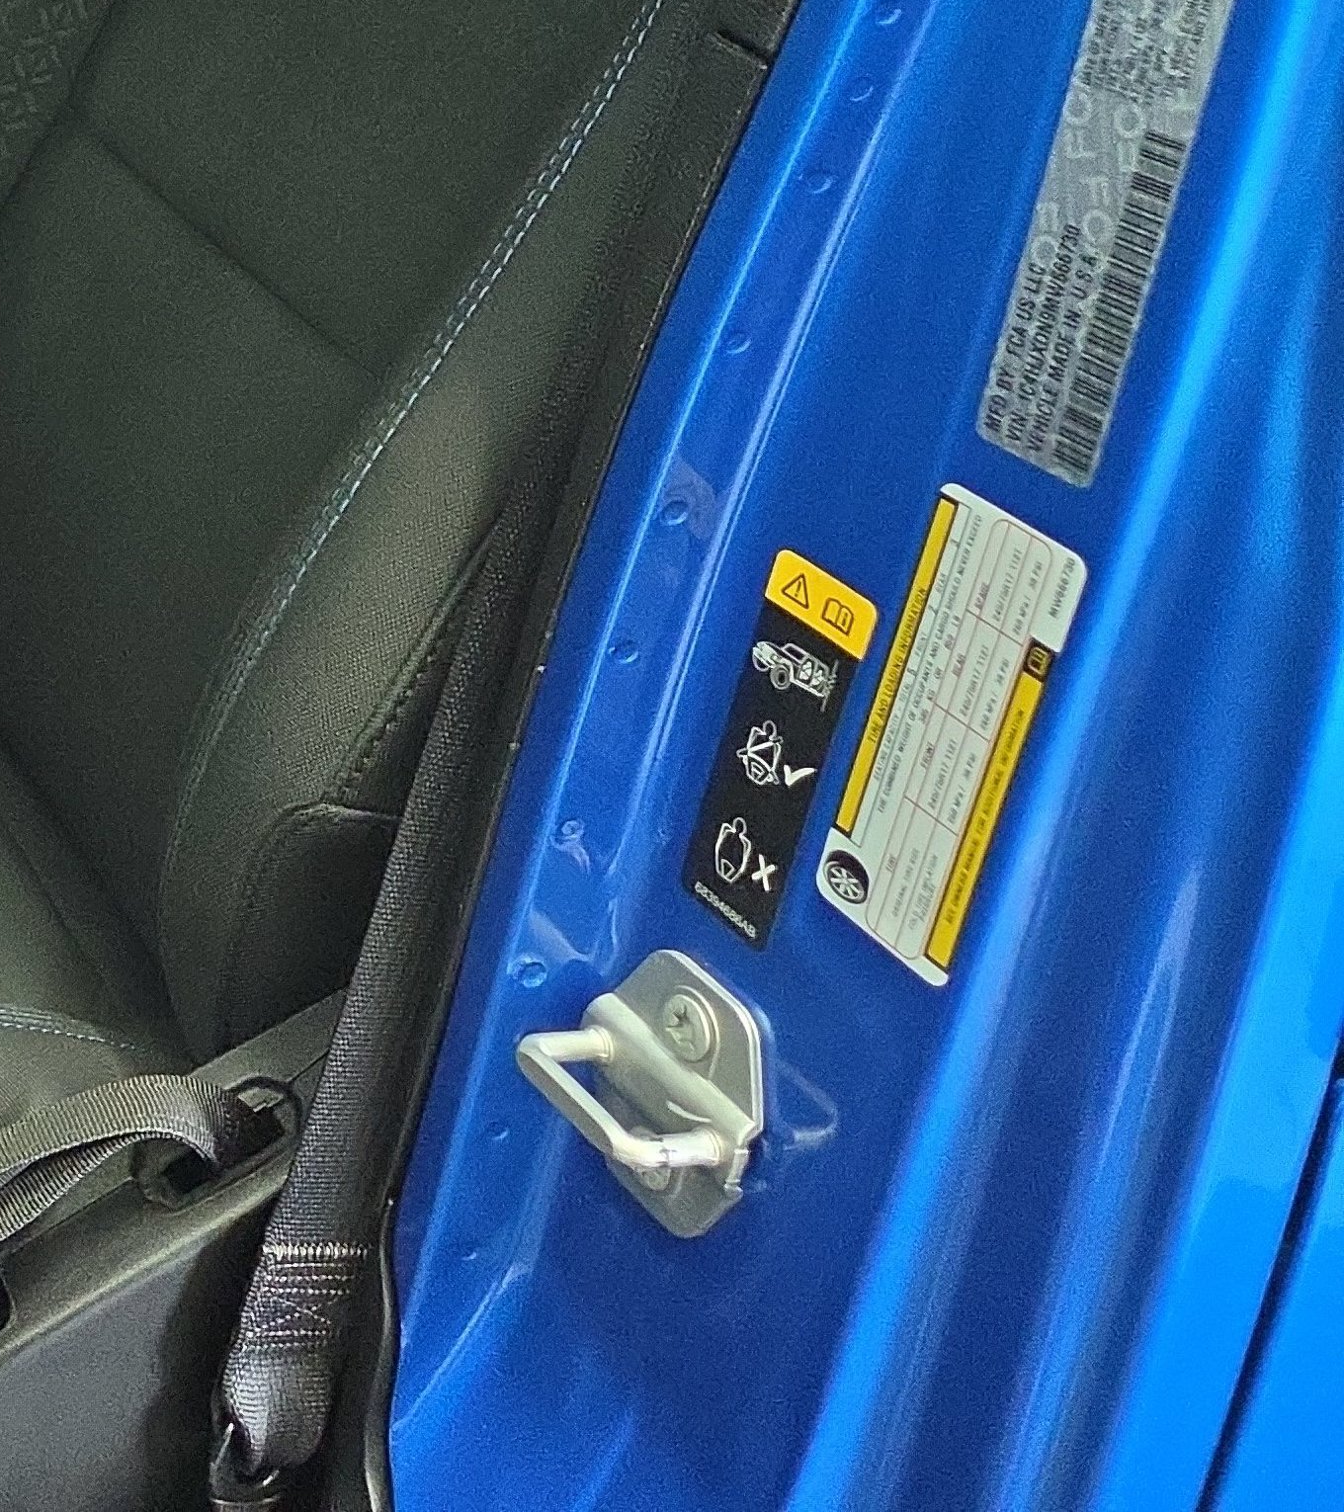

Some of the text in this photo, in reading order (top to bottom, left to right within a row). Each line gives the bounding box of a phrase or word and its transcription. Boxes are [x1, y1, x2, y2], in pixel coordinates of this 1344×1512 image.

[867, 588, 927, 743] TIRE AND LOADING INFORMATION
